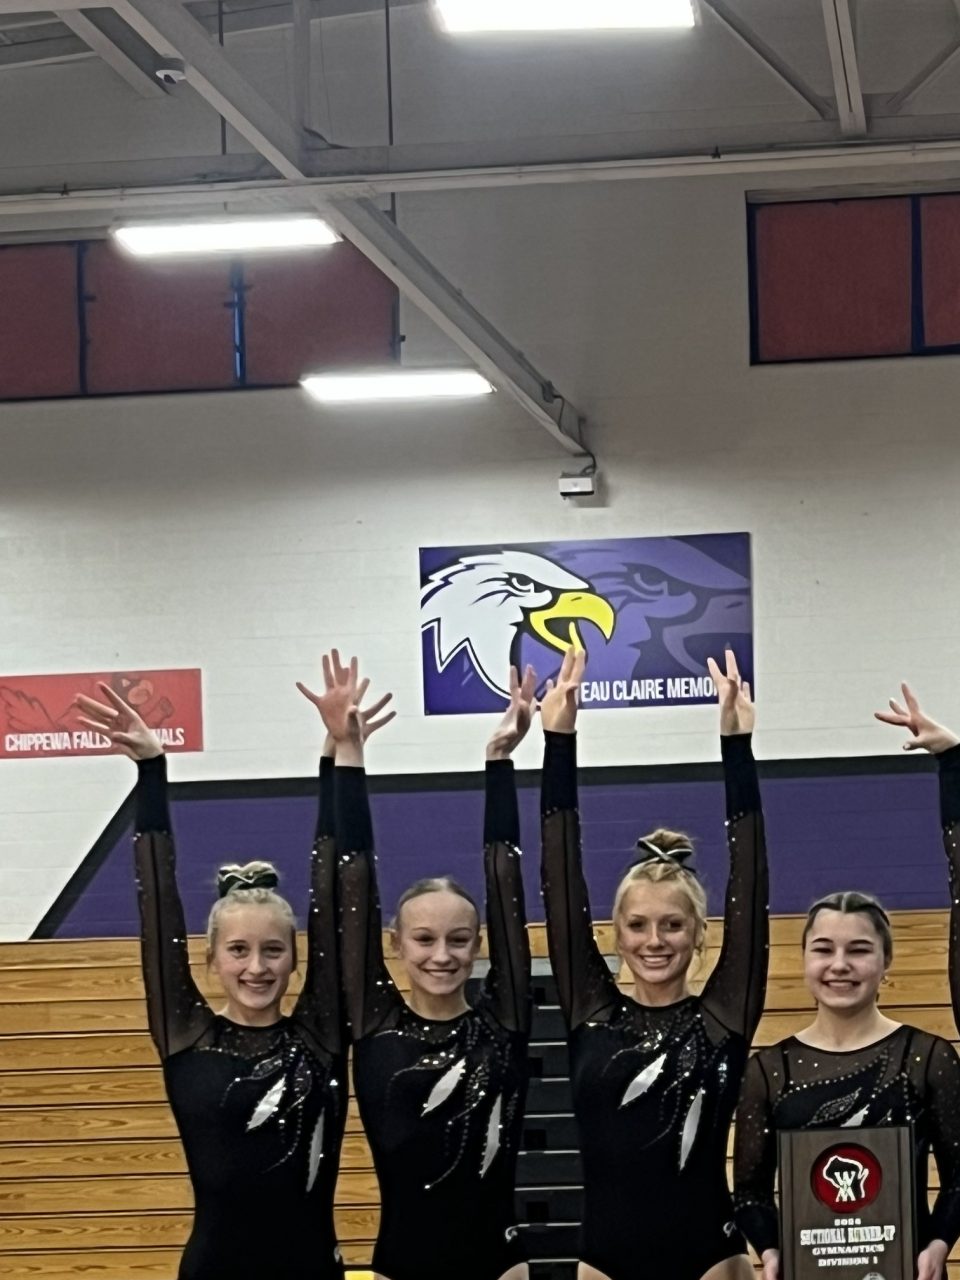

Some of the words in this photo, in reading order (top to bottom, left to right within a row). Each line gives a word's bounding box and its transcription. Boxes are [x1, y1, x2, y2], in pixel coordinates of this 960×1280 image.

[581, 680, 610, 703] EAU
[613, 678, 664, 701] CLAIRE
[666, 676, 719, 699] MEMO
[5, 732, 71, 751] CHIPPEWA
[812, 1244, 885, 1256] GYMNASTICS
[818, 1256, 870, 1267] DIVISION
